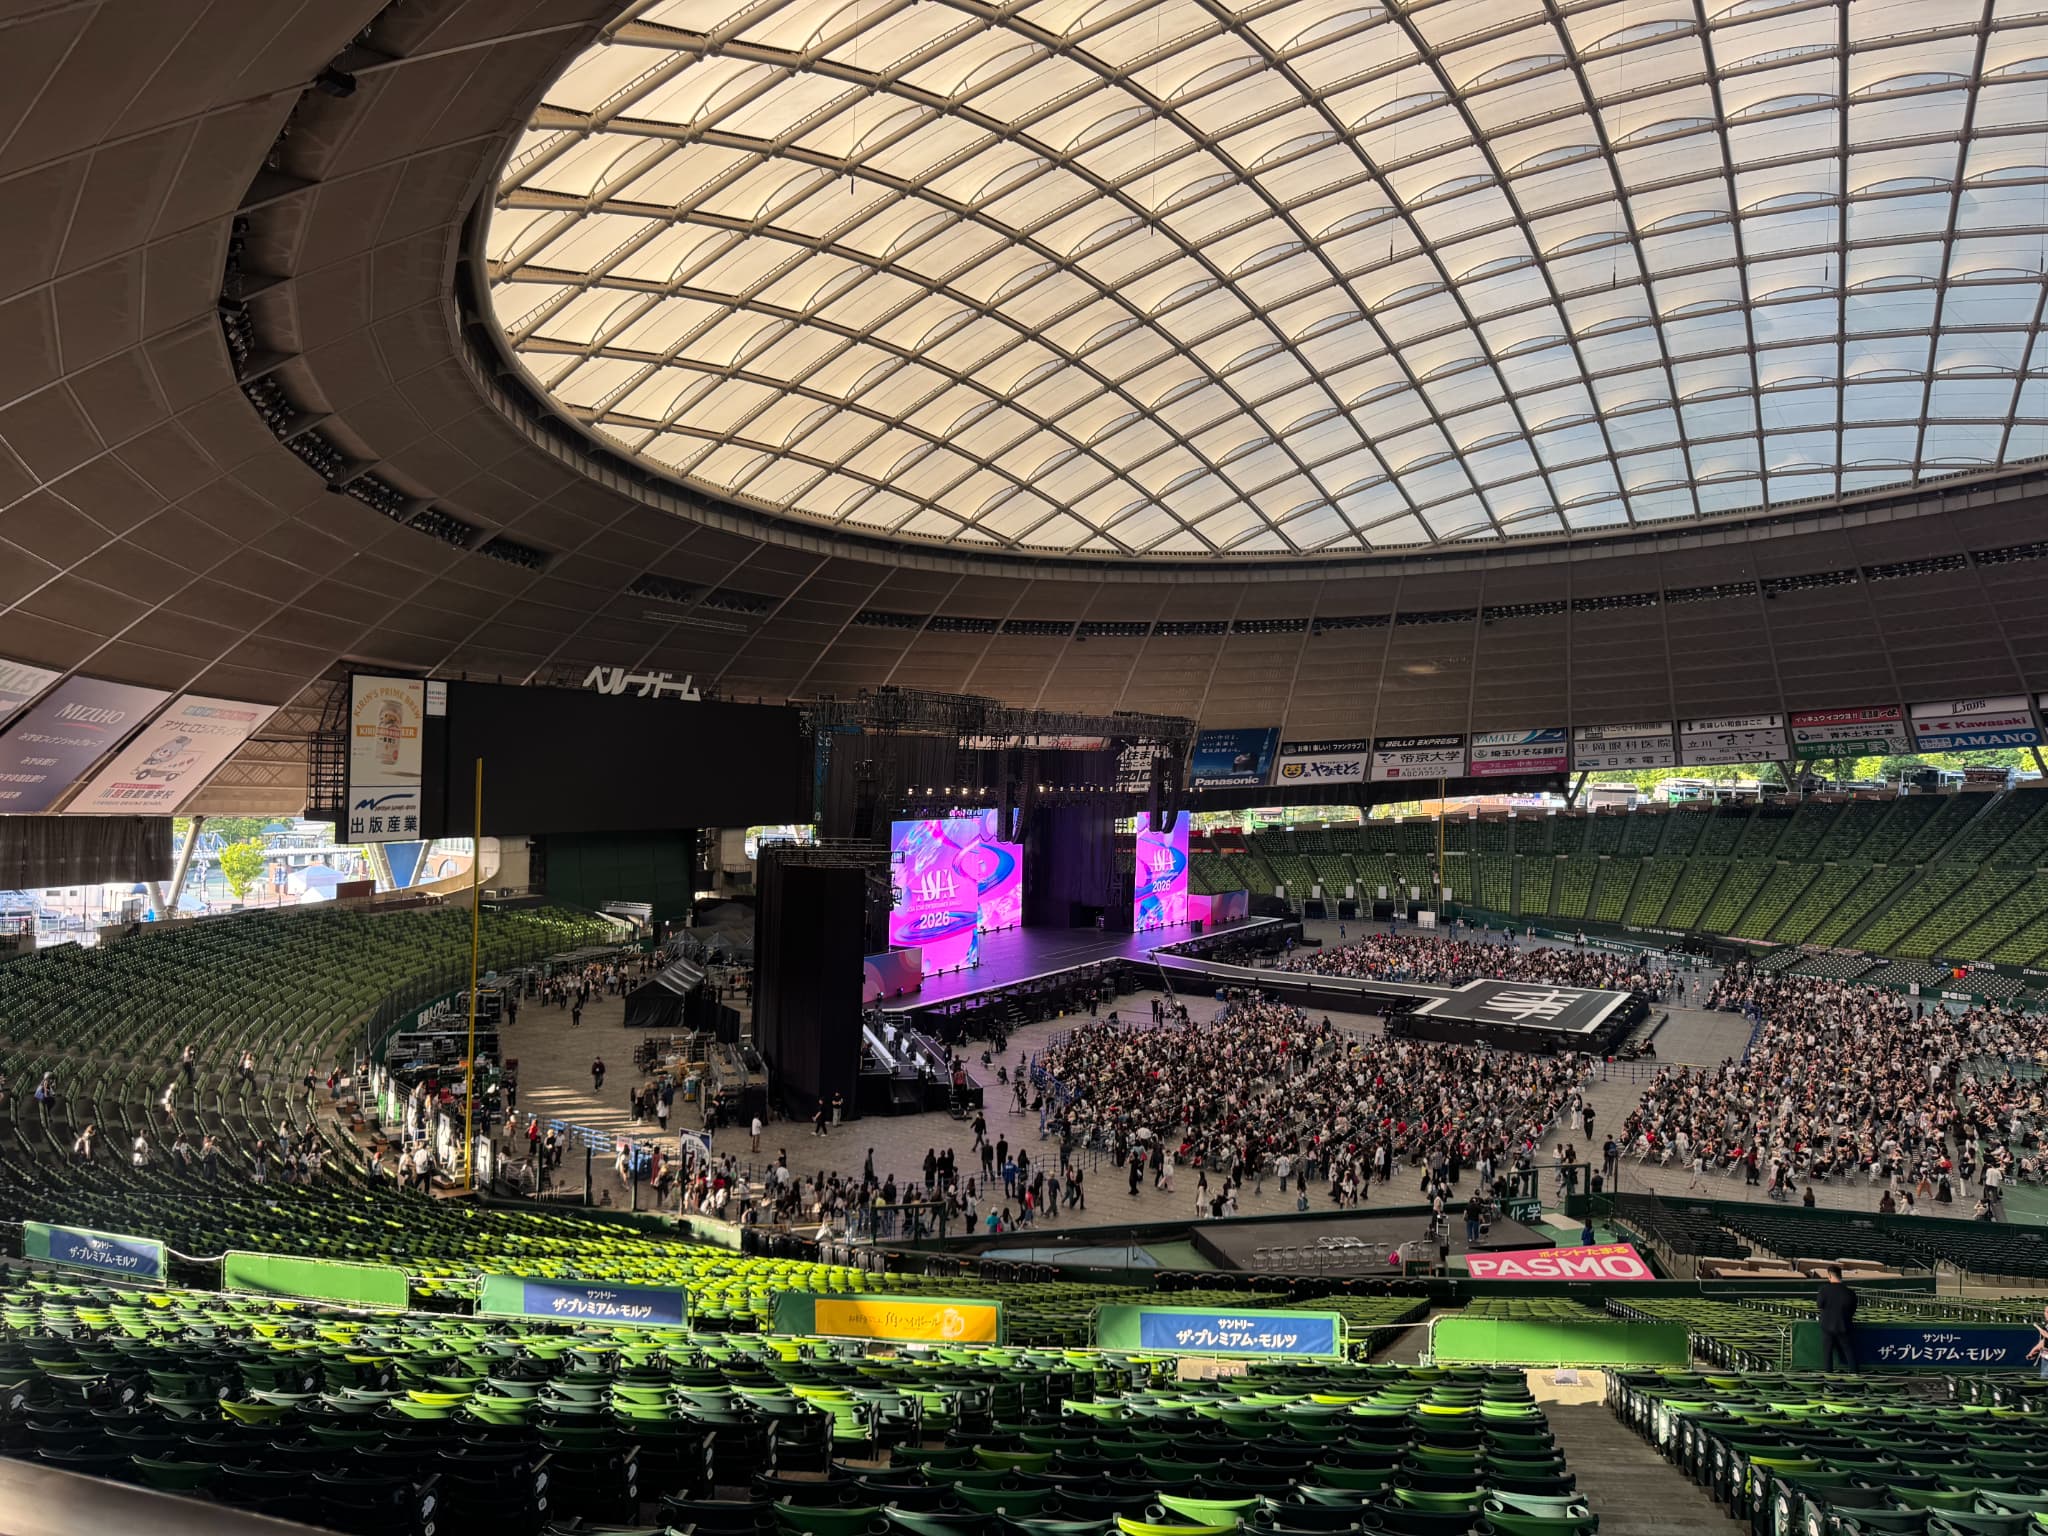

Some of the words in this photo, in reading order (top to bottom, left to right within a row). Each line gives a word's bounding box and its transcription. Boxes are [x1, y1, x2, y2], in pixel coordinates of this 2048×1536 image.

[54, 702, 125, 724] MIZUHO
[1955, 717, 2027, 729] Kawasaki
[1385, 739, 1415, 747] BELLO
[1416, 738, 1460, 746] EXPRESS
[1475, 733, 1519, 744] YAMATE
[1952, 732, 2037, 747] AMANO
[1400, 750, 1460, 763] 帝京大学
[1490, 746, 1565, 757] 埼玉りそな銀行
[1608, 755, 1672, 766] 日本電工
[1195, 776, 1259, 786] Panasonic
[351, 814, 417, 835] 出版産業
[1152, 880, 1171, 892] 2026
[920, 911, 950, 929] 2026
[69, 1246, 138, 1268] ザ・プレミアム・モルツ
[1539, 1246, 1630, 1259] ポイントたまる
[1469, 1256, 1645, 1277] PASMO
[587, 1290, 617, 1299] サントリー
[552, 1298, 652, 1318] ザ・プレミアム・モルツ
[1218, 1319, 1255, 1328] サントリー
[1176, 1330, 1298, 1348] ザ・プレミアム・モルツ
[1922, 1333, 1961, 1343] サントリー
[1877, 1343, 2007, 1362] ザ・プレミアム・モルツ
